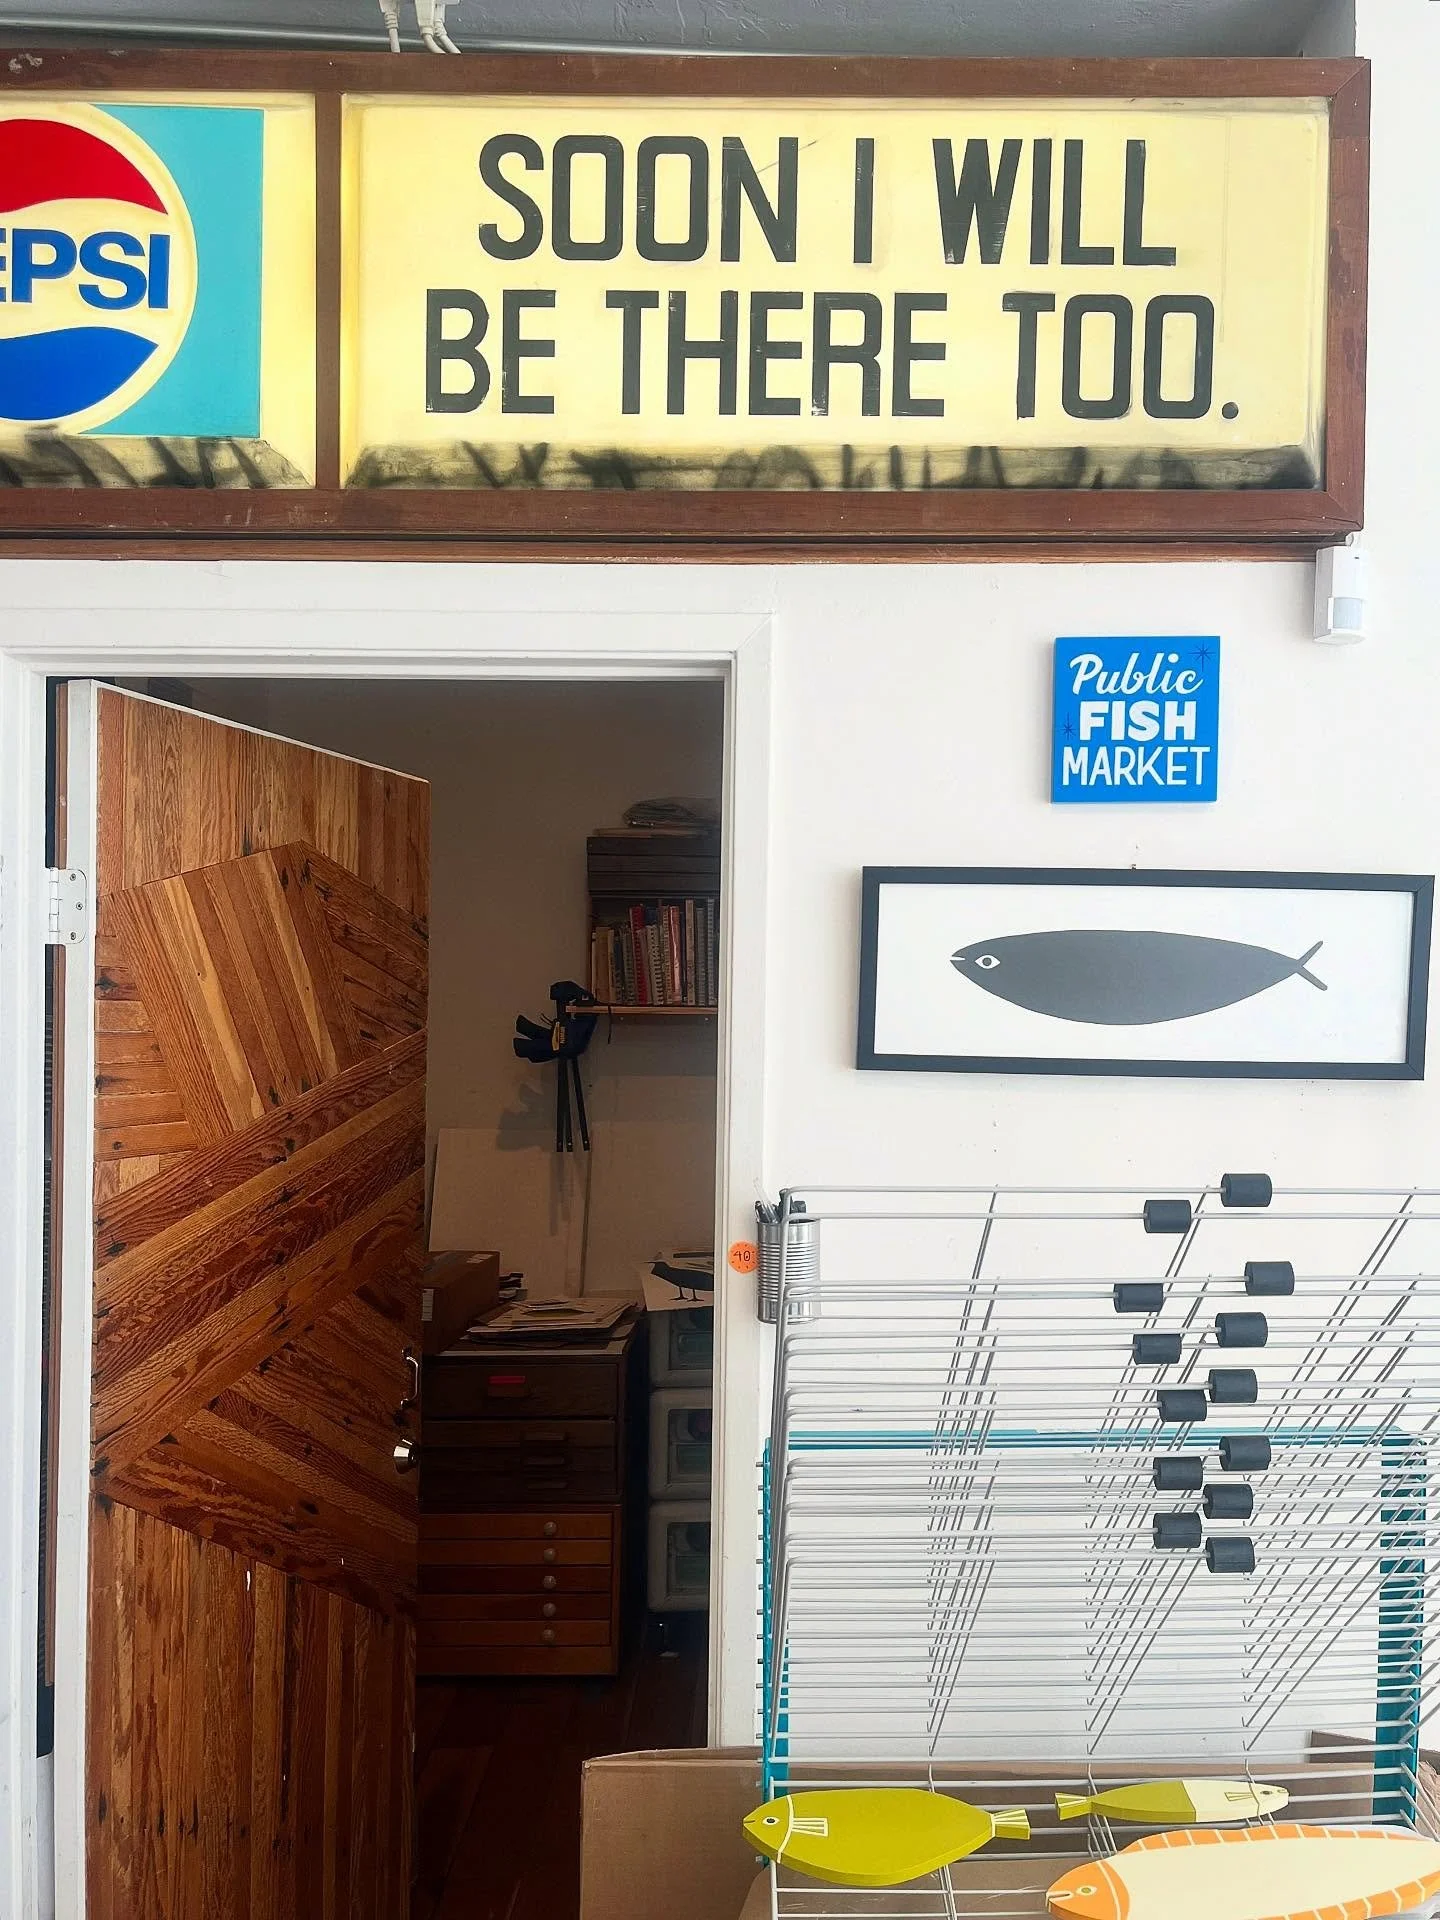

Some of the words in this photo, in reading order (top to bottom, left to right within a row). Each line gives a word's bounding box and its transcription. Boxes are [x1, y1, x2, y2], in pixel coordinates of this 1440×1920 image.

[479, 134, 798, 263] SOON
[854, 138, 874, 263] I
[932, 138, 1176, 266] WILL
[0, 228, 171, 311] PSI
[425, 289, 556, 414] BE
[605, 290, 948, 417] THERE
[1002, 292, 1239, 420] TOO.
[1069, 652, 1203, 695] Public
[1079, 700, 1197, 742] FISH
[1062, 746, 1211, 786] MARKET
